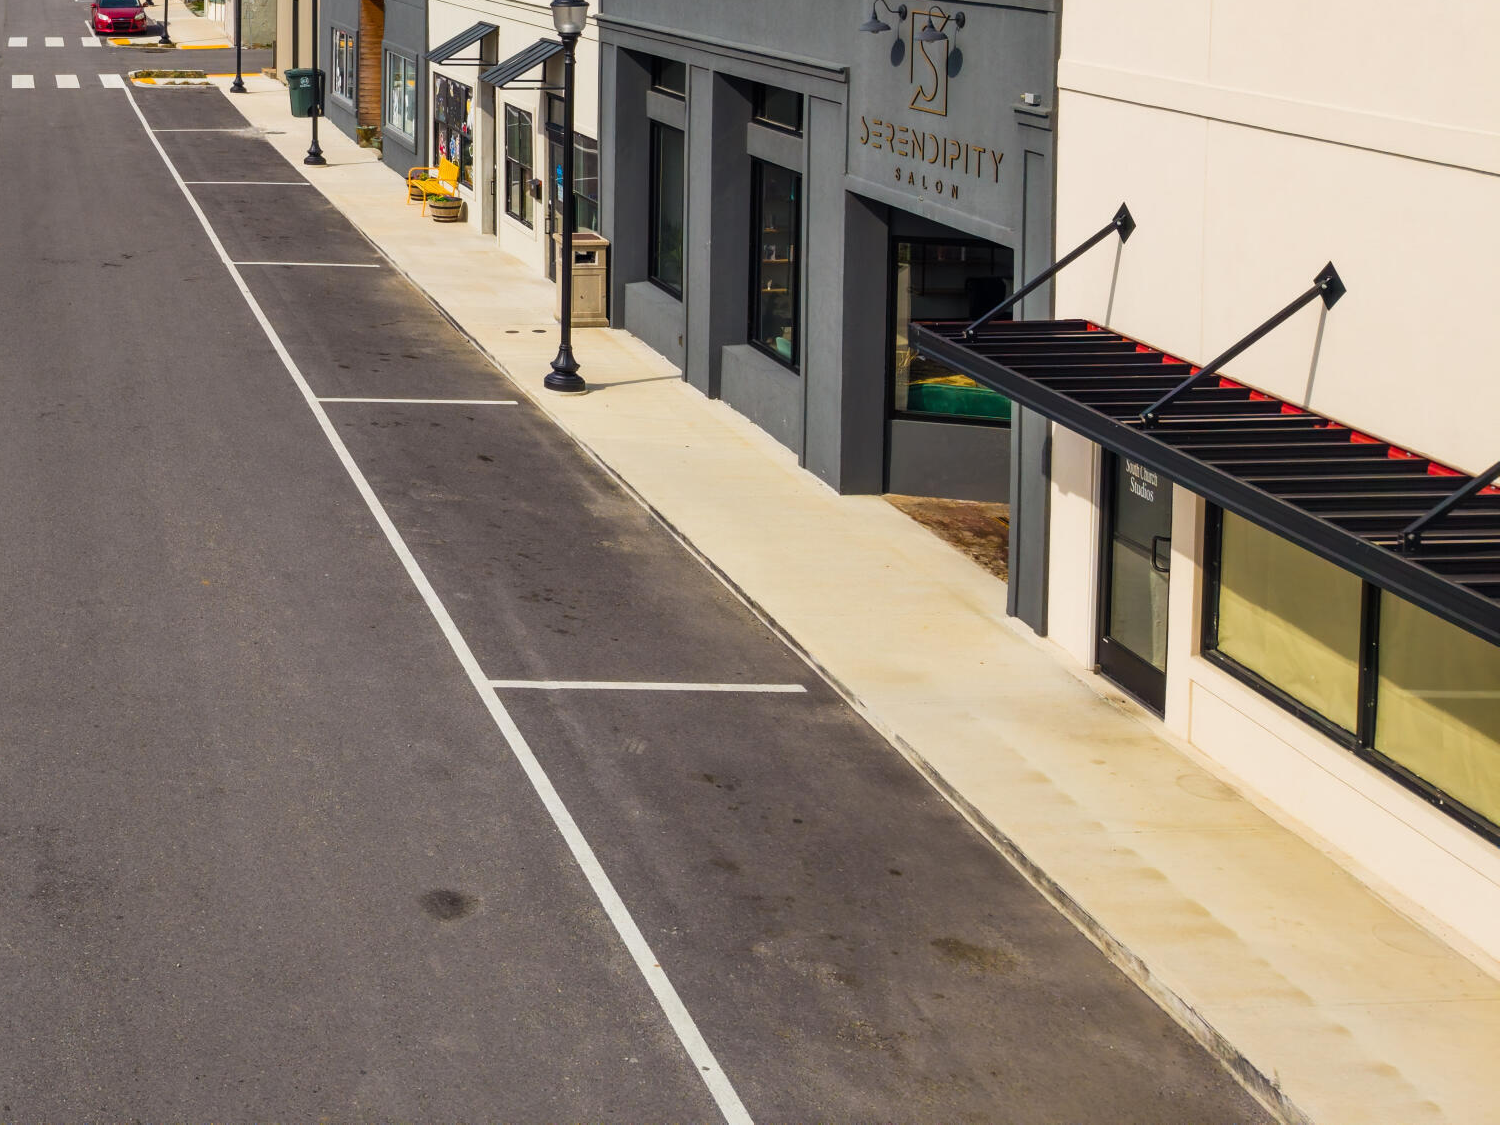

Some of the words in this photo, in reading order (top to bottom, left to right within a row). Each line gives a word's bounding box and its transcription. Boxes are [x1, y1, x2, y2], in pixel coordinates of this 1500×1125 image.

[860, 115, 1004, 184] SERENDIPITY
[894, 167, 959, 200] SALON
[1125, 459, 1140, 478] South
[1140, 465, 1158, 487] Church
[1130, 476, 1154, 502] Studios
